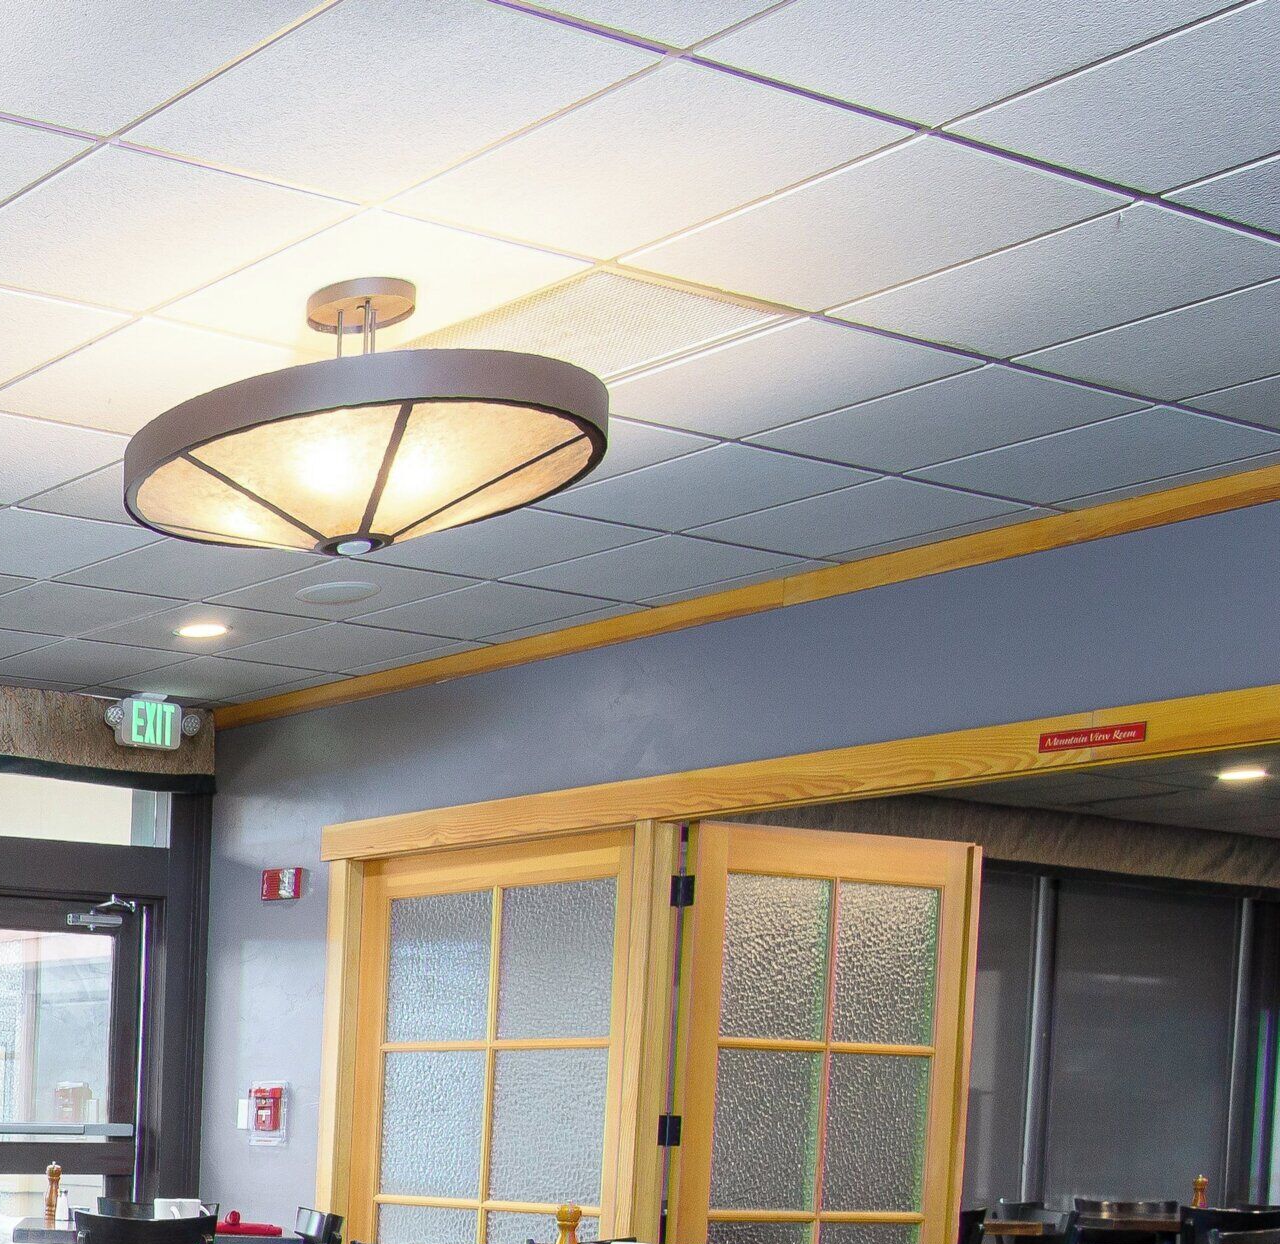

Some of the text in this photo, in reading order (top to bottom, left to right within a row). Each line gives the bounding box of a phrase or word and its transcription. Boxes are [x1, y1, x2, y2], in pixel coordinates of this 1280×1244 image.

[132, 700, 175, 746] EXIT
[1045, 729, 1137, 748] Mountain View Room
